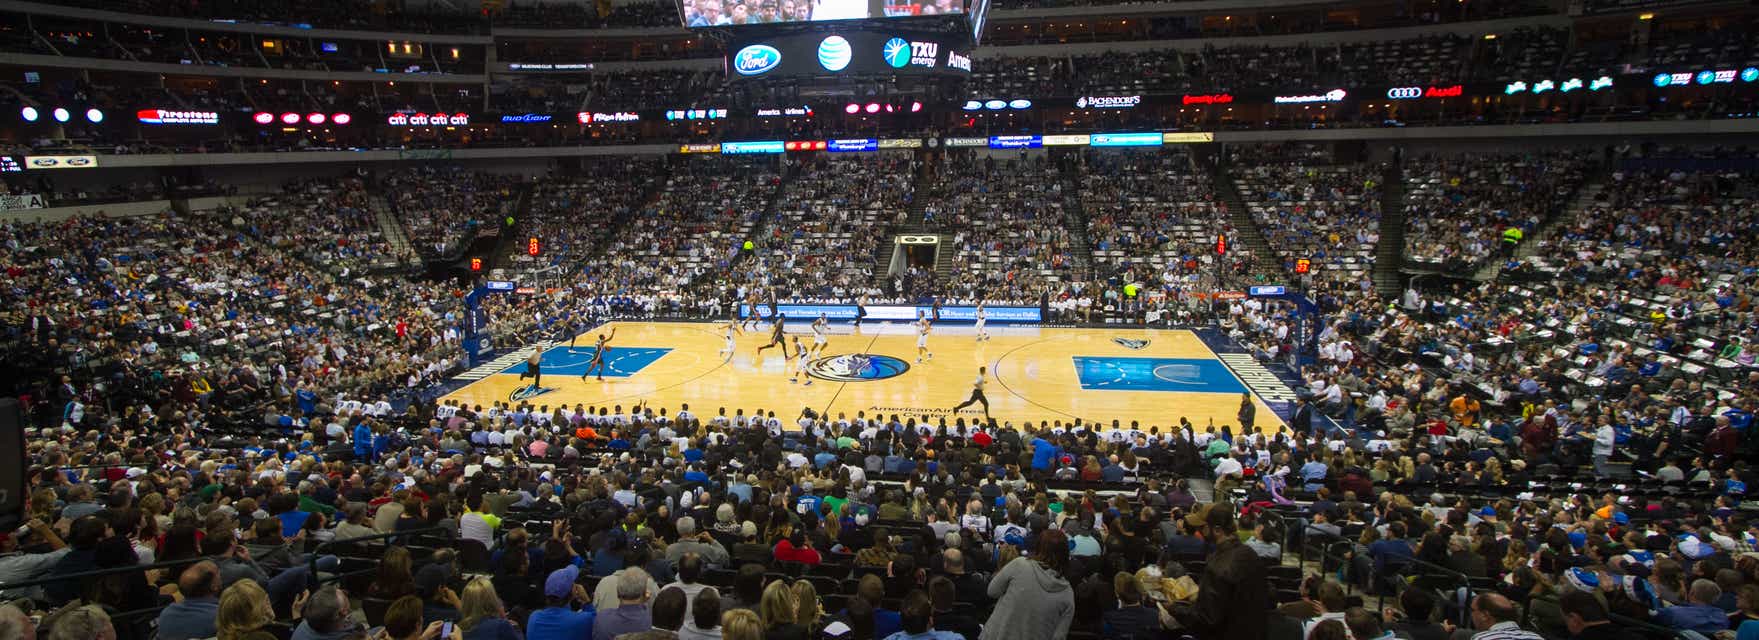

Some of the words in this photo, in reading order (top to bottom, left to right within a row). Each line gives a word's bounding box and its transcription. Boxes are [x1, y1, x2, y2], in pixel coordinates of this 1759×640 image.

[911, 42, 938, 58] TXU
[740, 49, 769, 70] Ford
[911, 57, 937, 68] energy
[1714, 70, 1737, 78] TXU
[1425, 85, 1463, 97] Audi
[388, 115, 407, 125] citi
[409, 115, 428, 125] citi
[430, 115, 448, 125] citi
[450, 115, 468, 125] citi
[30, 196, 42, 208] A
